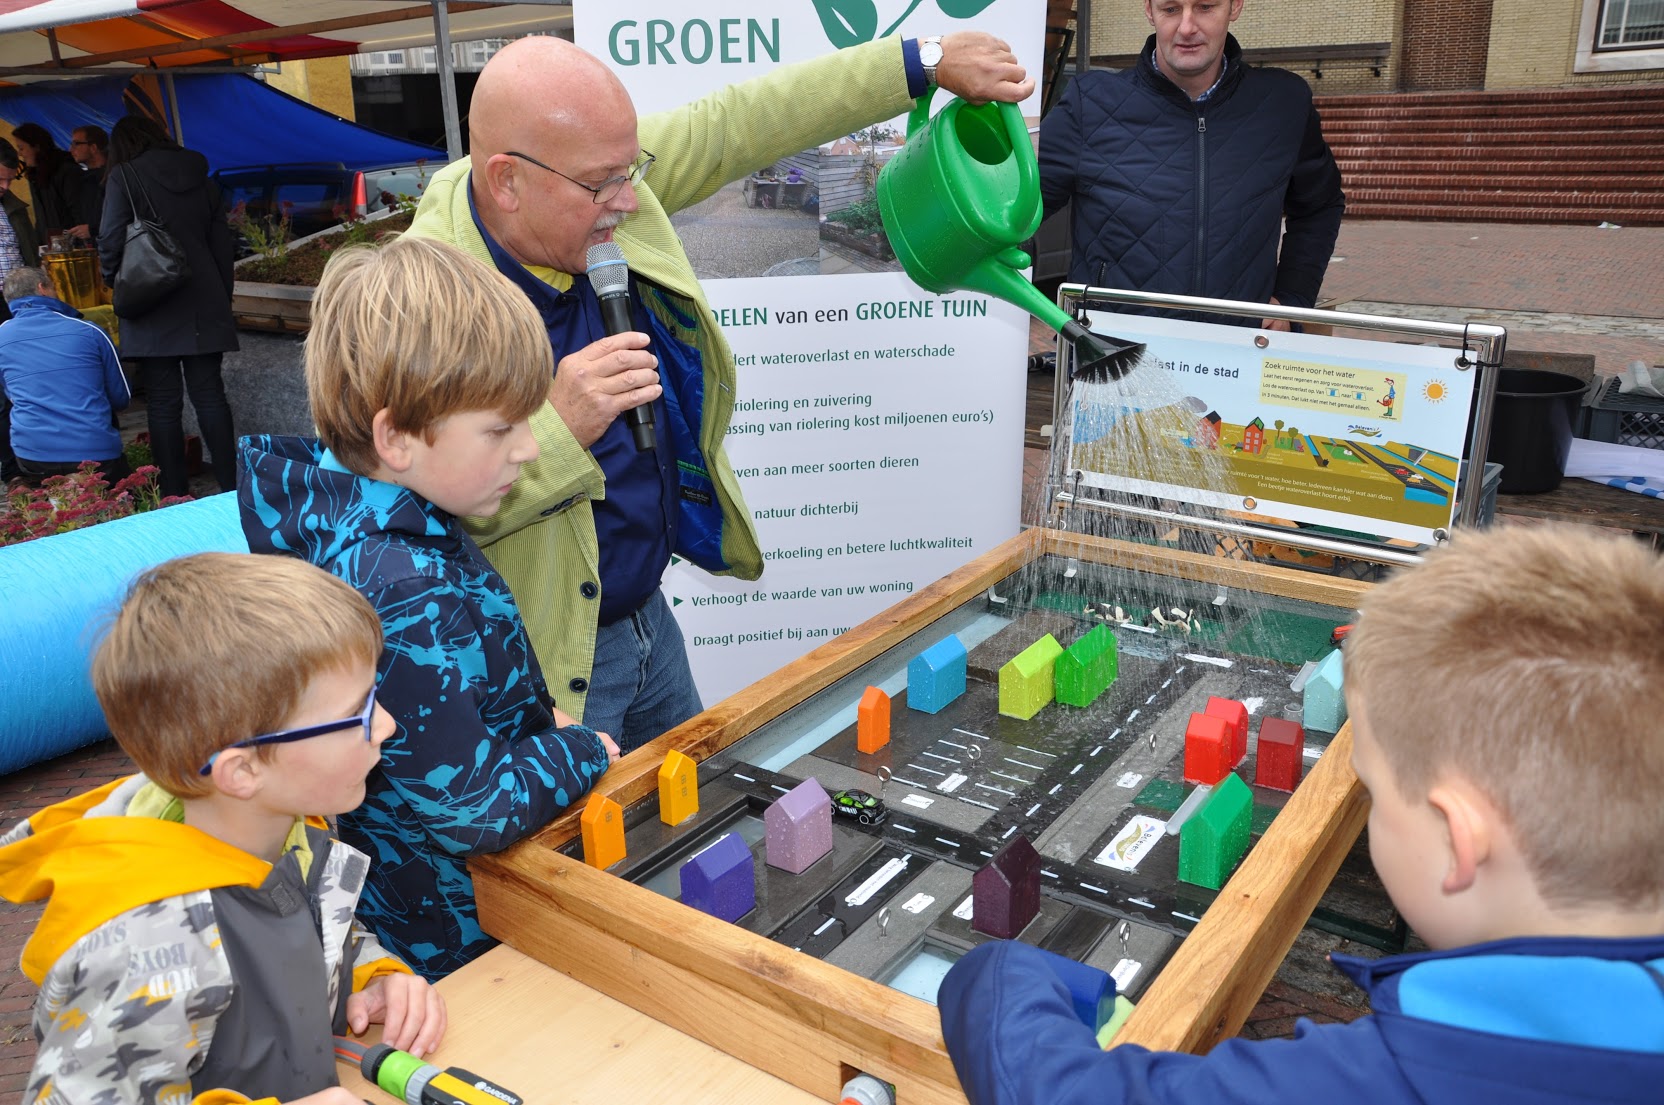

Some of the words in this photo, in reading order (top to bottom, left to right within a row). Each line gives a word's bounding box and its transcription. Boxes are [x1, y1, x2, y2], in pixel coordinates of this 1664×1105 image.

[608, 17, 781, 67] GROEN
[775, 310, 808, 325] van
[814, 308, 848, 323] een
[855, 300, 934, 321] GROENE
[941, 299, 987, 318] TUIN
[760, 348, 850, 365] wateroverlast
[853, 350, 870, 361] en
[874, 343, 955, 359] waterschade
[1179, 361, 1190, 373] in
[1194, 363, 1209, 375] de
[1213, 366, 1240, 379] stad
[1264, 361, 1282, 370] Zoek
[1282, 364, 1305, 373] ruimte
[1305, 367, 1322, 375] voor
[1322, 368, 1335, 377] het
[1335, 371, 1356, 379] water
[1320, 379, 1330, 387] zorg
[1342, 382, 1375, 391] wateroverlast.
[733, 398, 789, 413] riolering
[793, 398, 809, 409] en
[813, 394, 872, 408] zuivering
[1355, 403, 1370, 411] alleen.
[768, 422, 792, 432] van
[796, 416, 850, 431] riolering
[854, 414, 880, 427] kost
[884, 411, 948, 427] miljoenen
[732, 467, 760, 478] ven
[763, 466, 787, 477] aan
[791, 463, 825, 475] meer
[828, 459, 876, 472] soorten
[879, 456, 919, 469] dieren
[754, 507, 796, 520] natuur
[800, 501, 859, 517] dichterbij
[827, 546, 842, 556] en
[846, 542, 886, 555] betere
[889, 536, 973, 552] luchtkwaliteit
[691, 592, 748, 607] Verhoogt
[751, 590, 767, 602] de
[771, 586, 817, 601] waarde
[820, 587, 843, 597] van
[846, 585, 865, 596] uw
[869, 581, 914, 594] woning
[693, 633, 734, 647] Draagt
[738, 628, 784, 646] positief
[787, 627, 802, 641] bij
[806, 628, 828, 638] aan
[484, 1085, 517, 1105] GARDENA
